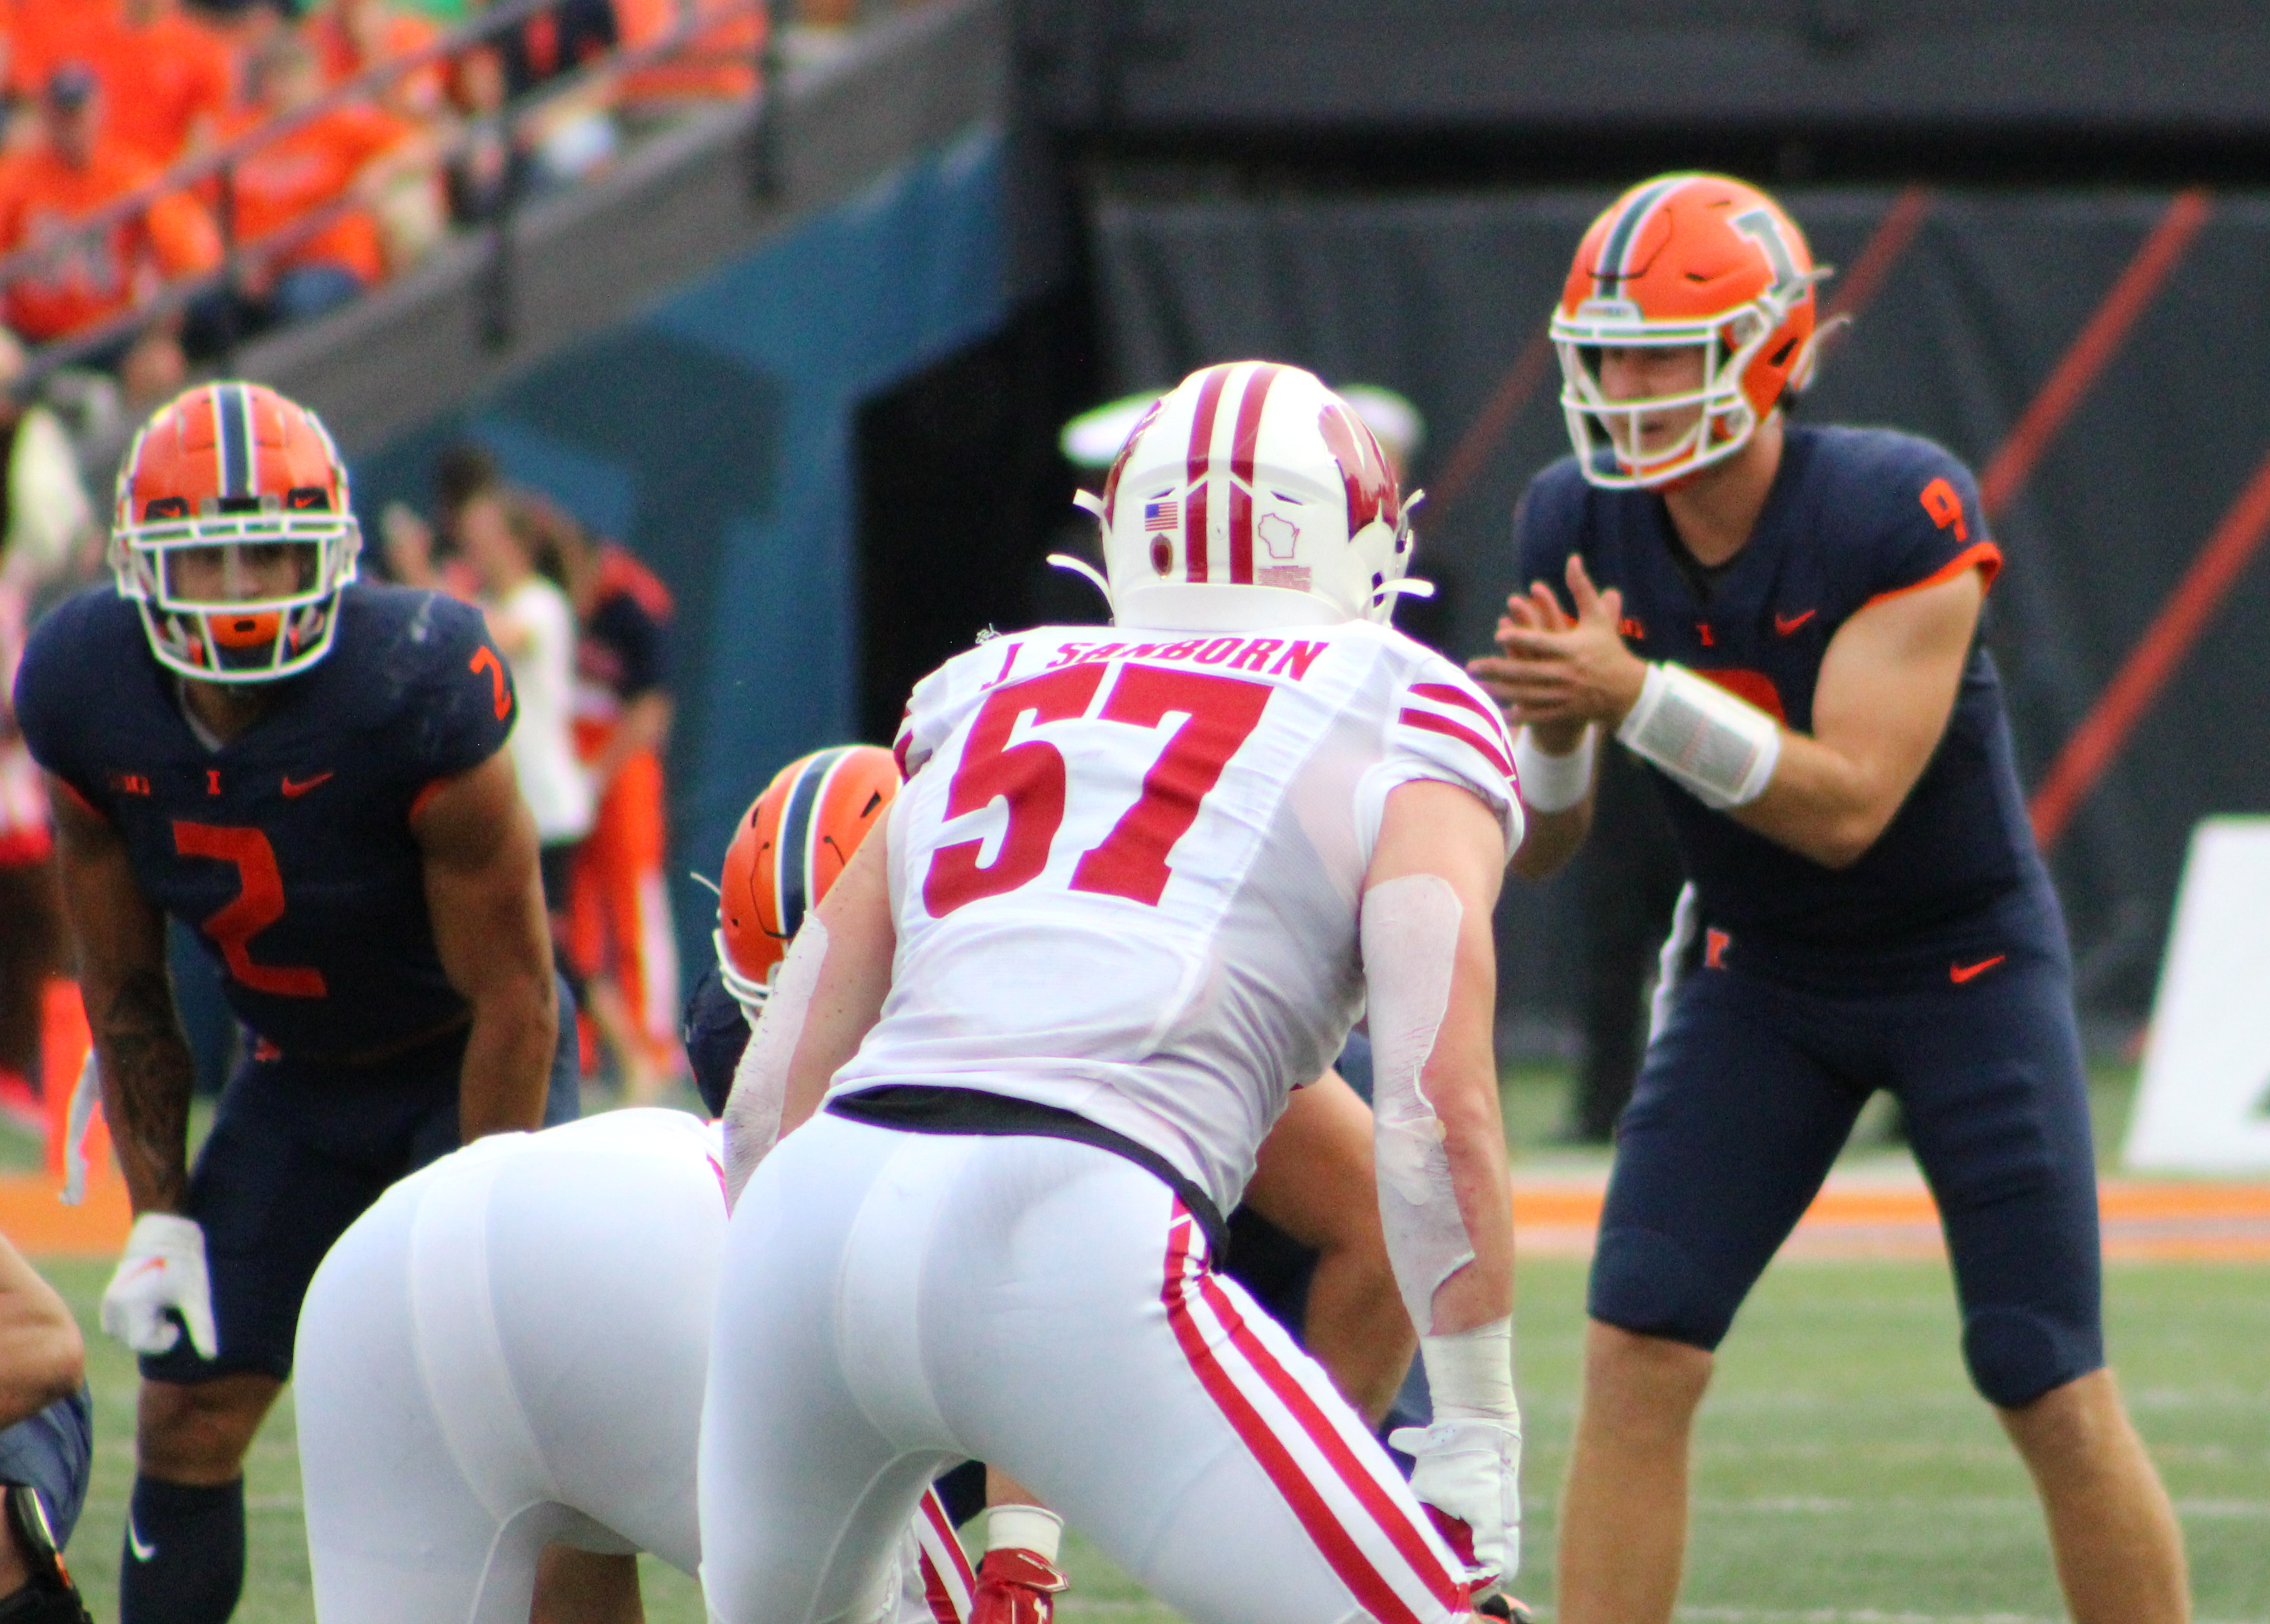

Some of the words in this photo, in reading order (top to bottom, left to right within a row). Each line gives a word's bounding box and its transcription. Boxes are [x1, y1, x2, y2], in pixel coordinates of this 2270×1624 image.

[1920, 478, 1966, 541] 9
[470, 646, 511, 720] 2
[1046, 638, 1330, 681] SANBORN
[207, 770, 221, 794] I
[923, 661, 1274, 919] 57
[172, 820, 327, 998] 2
